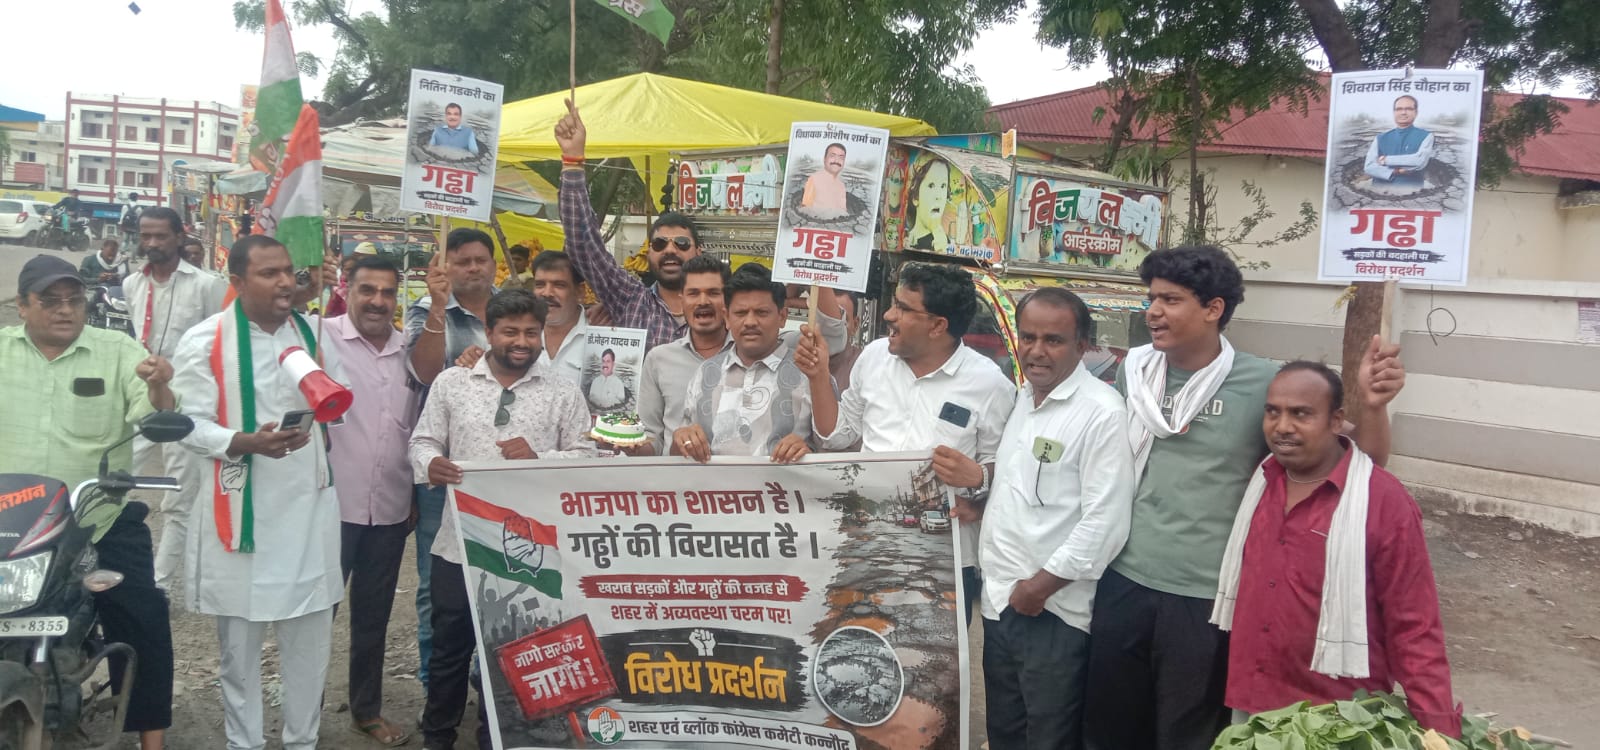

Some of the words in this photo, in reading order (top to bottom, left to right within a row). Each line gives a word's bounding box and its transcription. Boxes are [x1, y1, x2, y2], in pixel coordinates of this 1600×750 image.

[419, 78, 447, 94] नितिन
[450, 84, 482, 99] गडकरी
[483, 91, 496, 102] का
[1342, 80, 1385, 94] शिवराज
[1388, 78, 1410, 92] सिंह
[1414, 76, 1452, 92] चौहान
[1452, 81, 1470, 93] का
[851, 133, 869, 144] शर्मा
[869, 136, 882, 145] का
[794, 268, 812, 279] विरोध
[814, 272, 840, 283] प्रदर्शन
[1356, 262, 1387, 274] विरोध
[1389, 264, 1426, 276] प्रदर्शन
[611, 336, 630, 347] यादव
[630, 338, 640, 348] का
[560, 490, 640, 517] भाजपा
[641, 490, 678, 515] का
[684, 490, 766, 515] शासन
[623, 522, 662, 558] की
[666, 522, 771, 559] विरासत
[774, 522, 799, 559] है
[597, 581, 632, 594] खराब
[634, 579, 670, 598] सड़कों
[673, 579, 696, 596] और
[723, 579, 741, 596] की
[744, 581, 772, 596] वजह
[776, 578, 788, 596] से
[611, 604, 641, 620] शहर
[642, 602, 658, 620] में
[662, 605, 728, 622] अव्यवस्था
[730, 606, 764, 622] चरम
[766, 607, 793, 625] पर!
[513, 644, 544, 669] जागो
[624, 651, 702, 696] विरोध
[705, 656, 787, 703] प्रदर्शन
[629, 720, 658, 735] शहर
[660, 717, 681, 736] एवं
[682, 716, 719, 736] ब्लॉक
[720, 720, 762, 740] कांग्रेस
[762, 725, 802, 744] कमेटी
